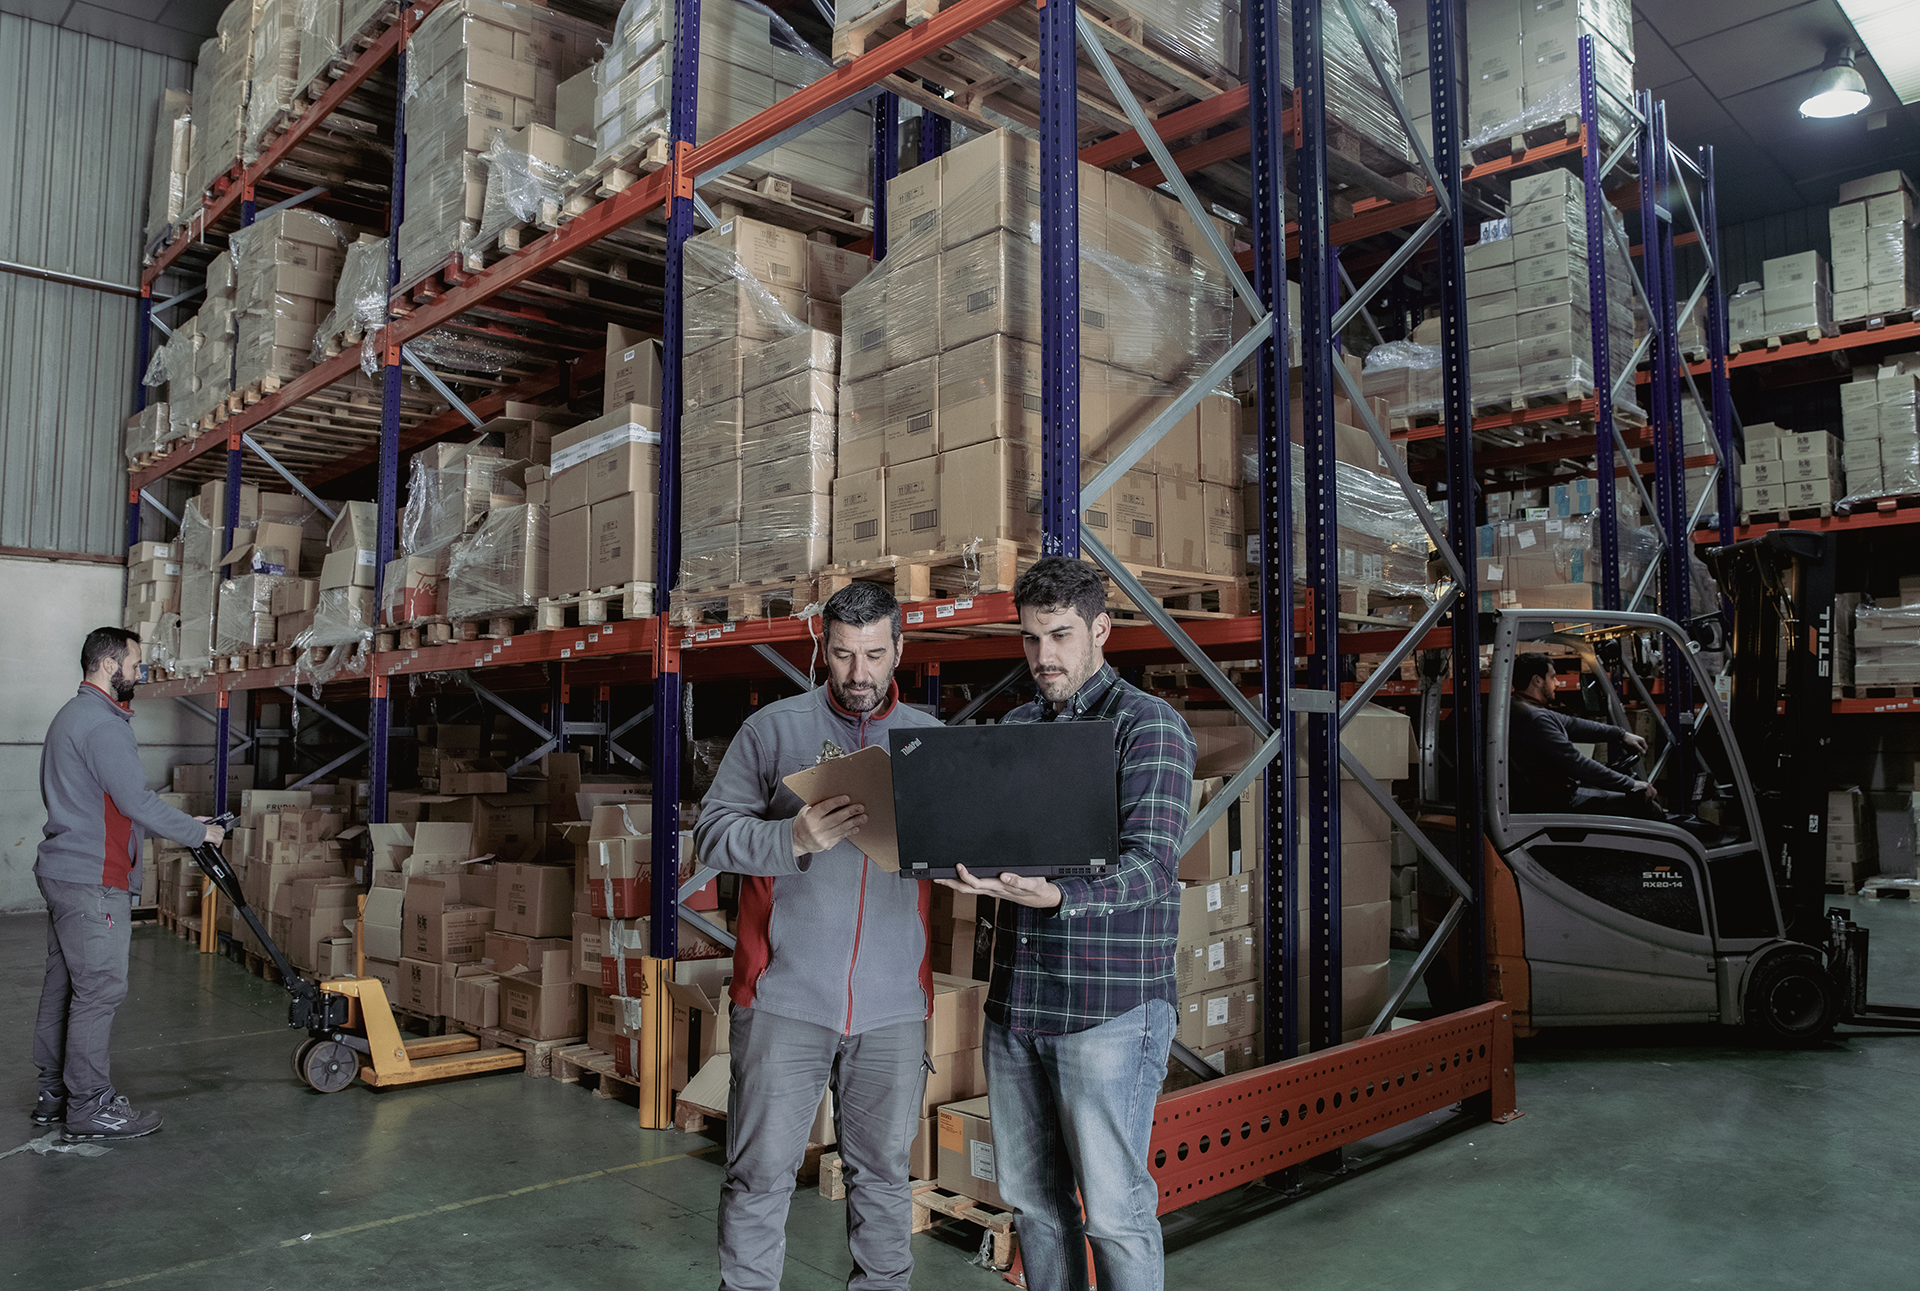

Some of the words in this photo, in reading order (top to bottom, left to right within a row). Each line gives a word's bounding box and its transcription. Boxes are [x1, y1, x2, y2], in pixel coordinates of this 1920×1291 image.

[1818, 605, 1831, 678] STILL
[900, 737, 923, 757] ThinkPad
[1642, 871, 1683, 879] STILL
